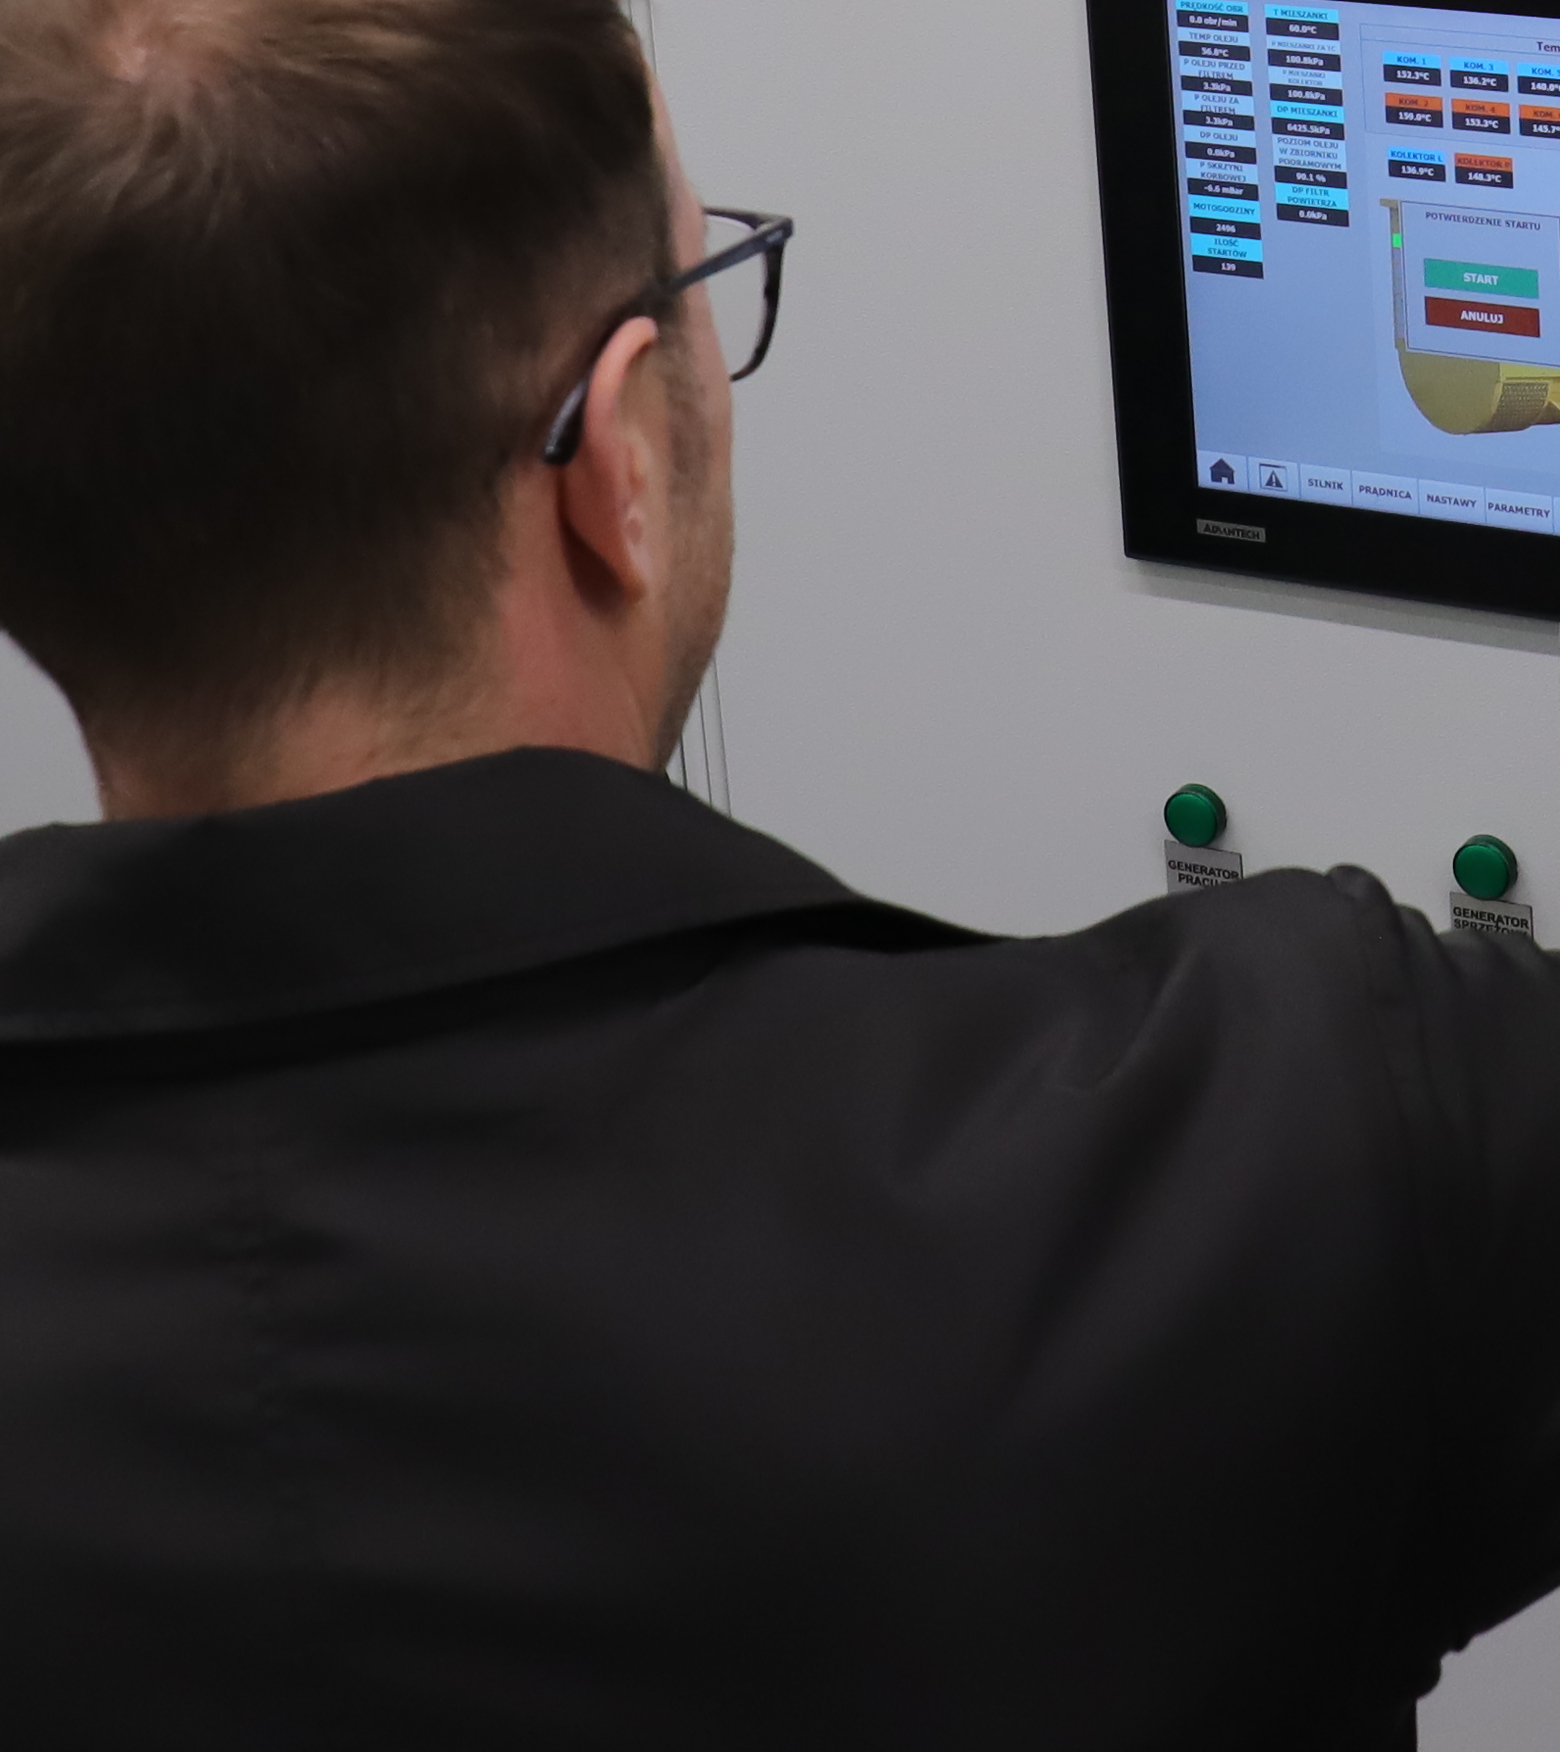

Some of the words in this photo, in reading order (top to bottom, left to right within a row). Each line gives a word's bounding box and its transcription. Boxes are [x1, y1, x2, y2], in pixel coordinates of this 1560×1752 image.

[1280, 9, 1328, 20] MIESZANKI
[1213, 33, 1238, 43] OLEJU
[1191, 59, 1216, 68] OLEJU
[1219, 62, 1245, 70] PRZED
[1397, 55, 1419, 65] KOM.
[1464, 61, 1486, 71] KOM.
[1531, 67, 1554, 77] KOM.
[1291, 106, 1338, 118] MIESZANKI
[1213, 132, 1238, 141] OLEJU
[1313, 140, 1339, 149] OLEJU
[1290, 148, 1338, 160] ZBIORNIKU
[1390, 150, 1435, 163] KOLEKTOR
[1292, 185, 1304, 194] DP
[1306, 187, 1330, 196] FILTR
[1288, 196, 1337, 207] POWIETRZA
[1193, 202, 1255, 216] MOTOGODZINY
[1425, 211, 1502, 227] POTWIERDZENIE
[1505, 219, 1541, 230] STARTU
[1214, 237, 1239, 247] ILOŚĆ
[1207, 247, 1247, 258] STARTÓW
[1463, 272, 1499, 286] START
[1460, 310, 1504, 324] ANULUJ
[1308, 478, 1343, 490] SILNIK
[1359, 485, 1412, 500] PRĄDNICA
[1427, 494, 1477, 509] NASTAWY
[1488, 502, 1551, 519] PARAMETRY
[1203, 524, 1260, 540] ADVANTECH
[1168, 860, 1239, 879] GENERATOR
[1178, 873, 1228, 886] PRACU
[1453, 906, 1529, 929] GENERATOR
